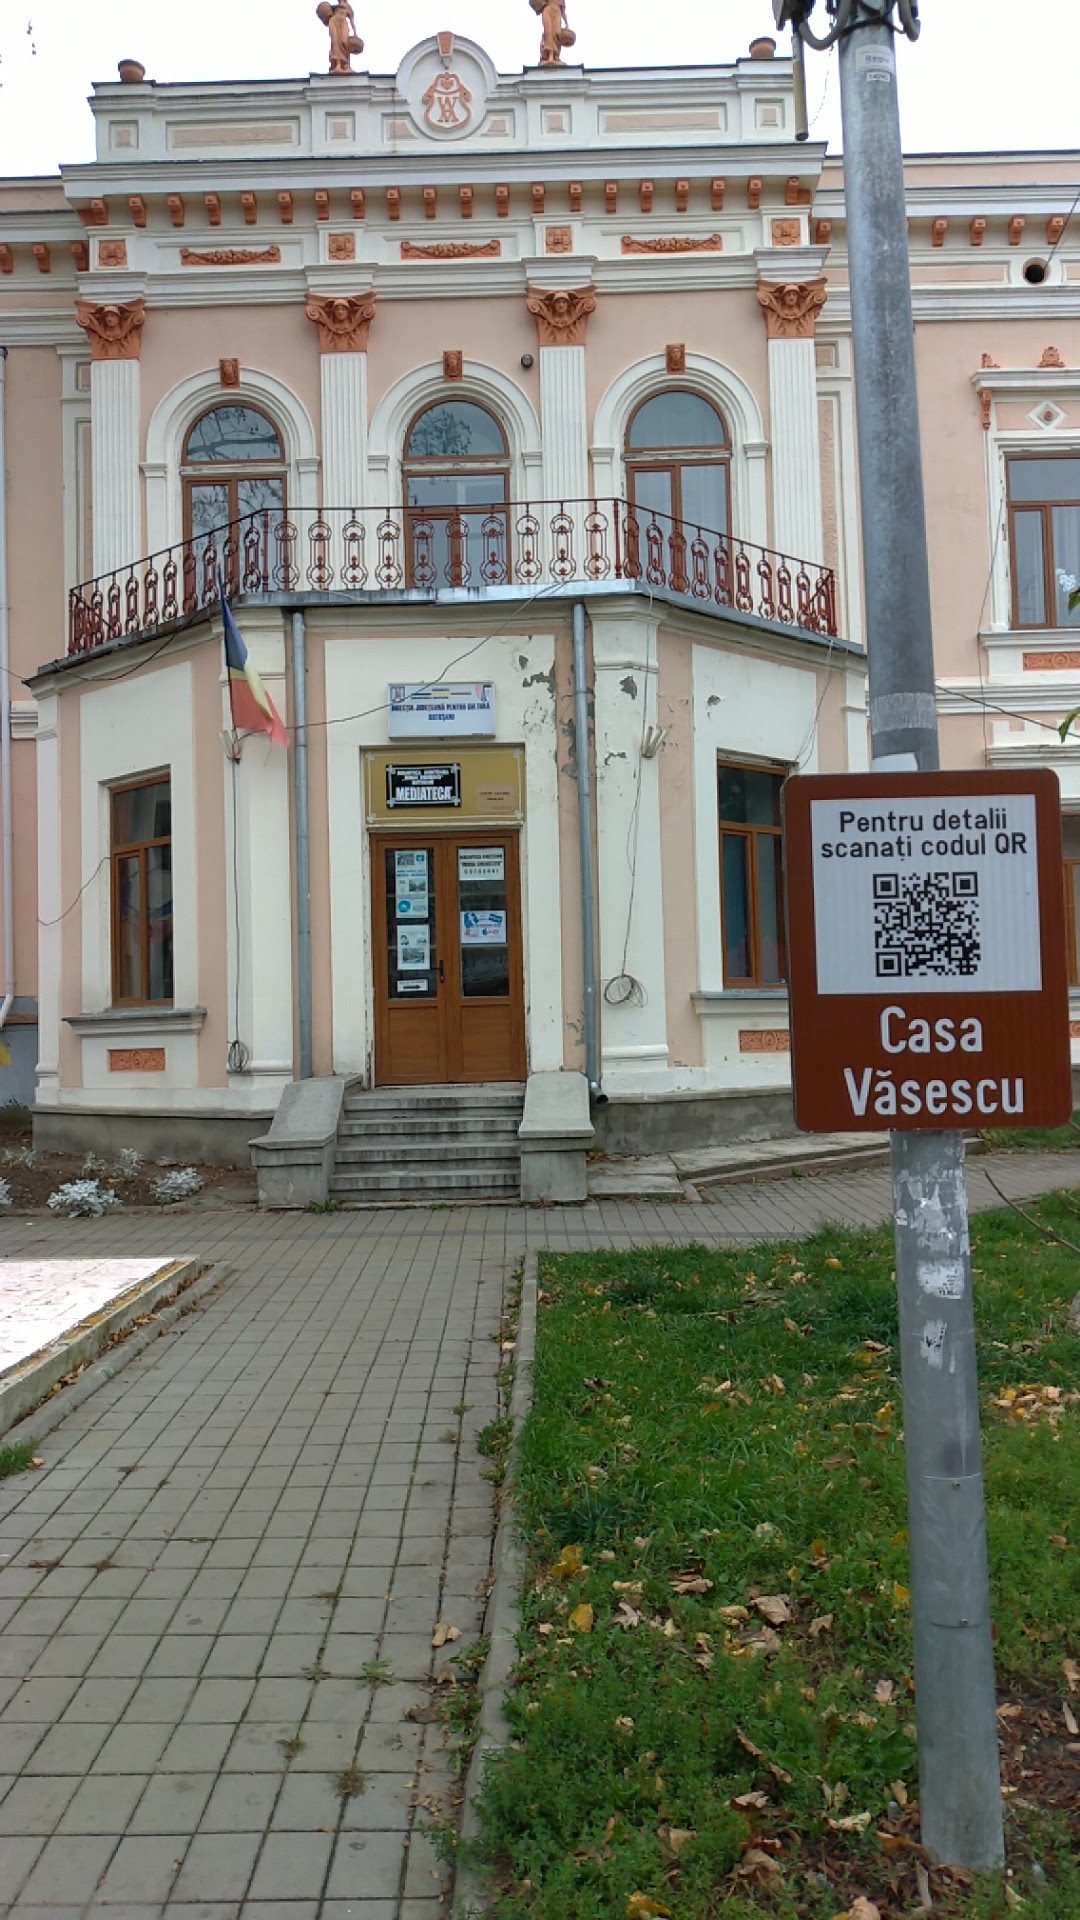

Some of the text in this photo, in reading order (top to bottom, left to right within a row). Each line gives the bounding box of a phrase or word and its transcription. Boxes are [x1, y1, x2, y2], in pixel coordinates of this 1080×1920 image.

[839, 808, 1007, 833] Pentru detalii
[821, 832, 1027, 861] scanați codul QR
[880, 1005, 983, 1054] Casa
[843, 1067, 1024, 1116] Văsescu
